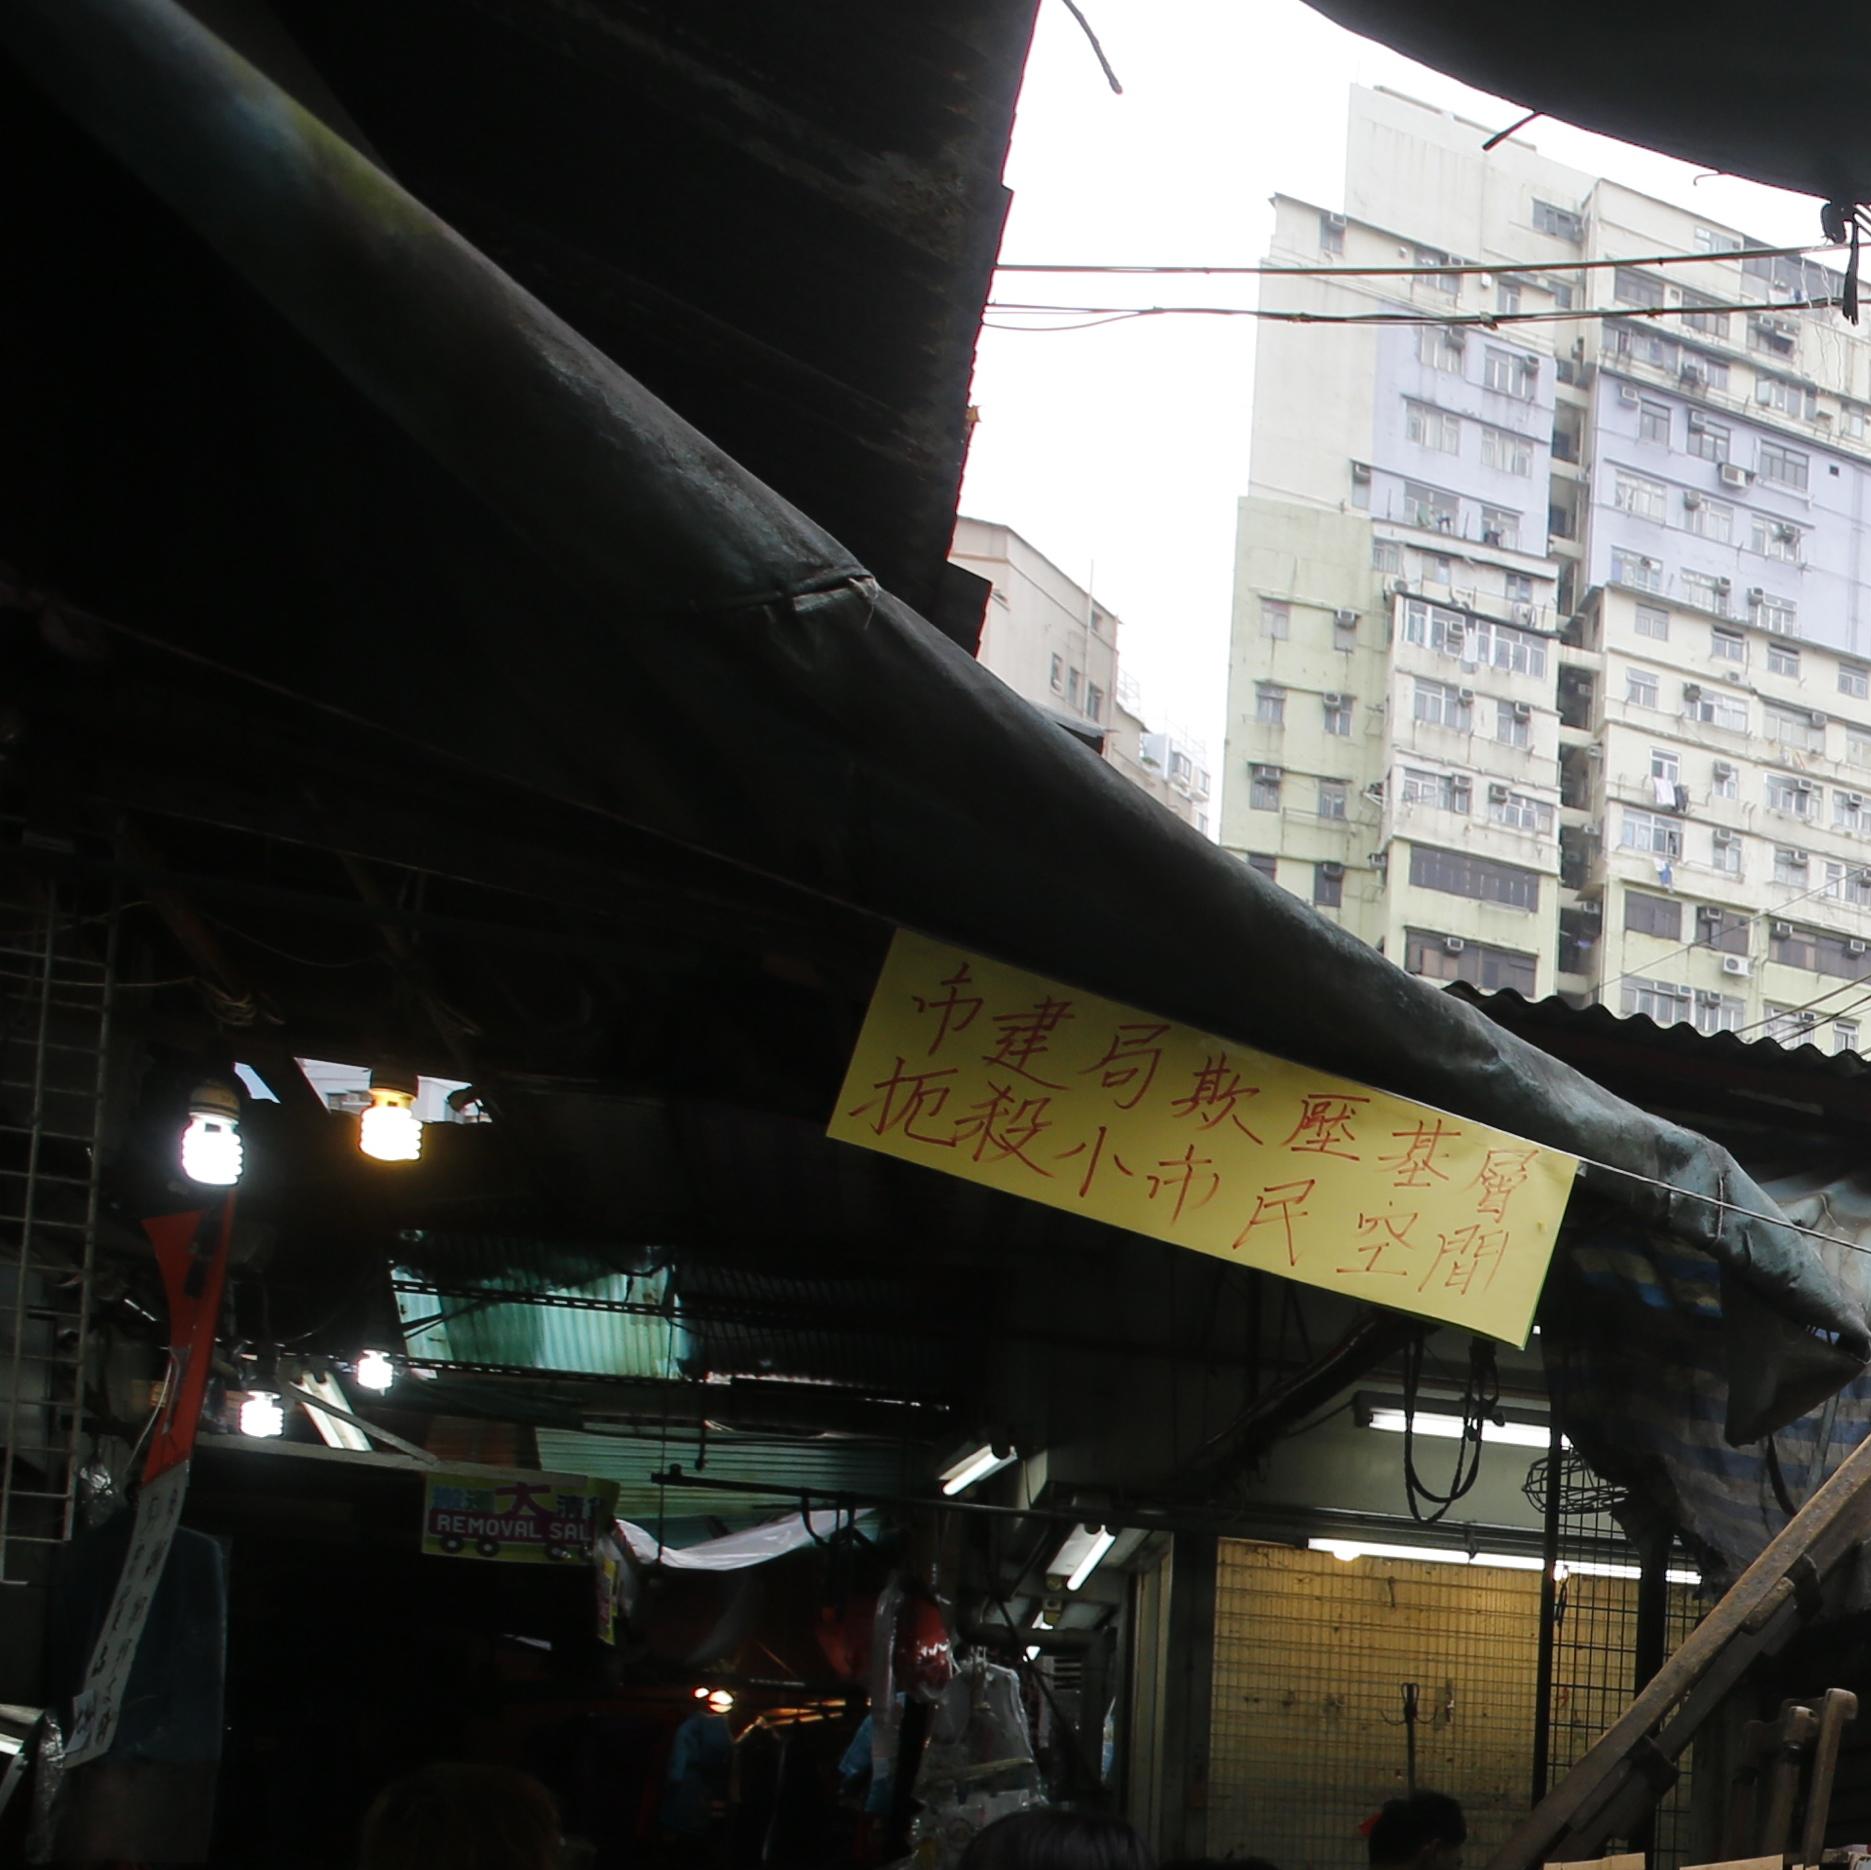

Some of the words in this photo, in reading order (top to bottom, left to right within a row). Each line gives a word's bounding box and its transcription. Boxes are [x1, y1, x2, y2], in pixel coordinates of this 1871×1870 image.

[849, 1056, 1510, 1295] 扼殺小市民空間
[914, 963, 1538, 1224] 市建局欺壓基層
[437, 1515, 543, 1538] REMOVAL
[549, 1523, 592, 1541] SAL
